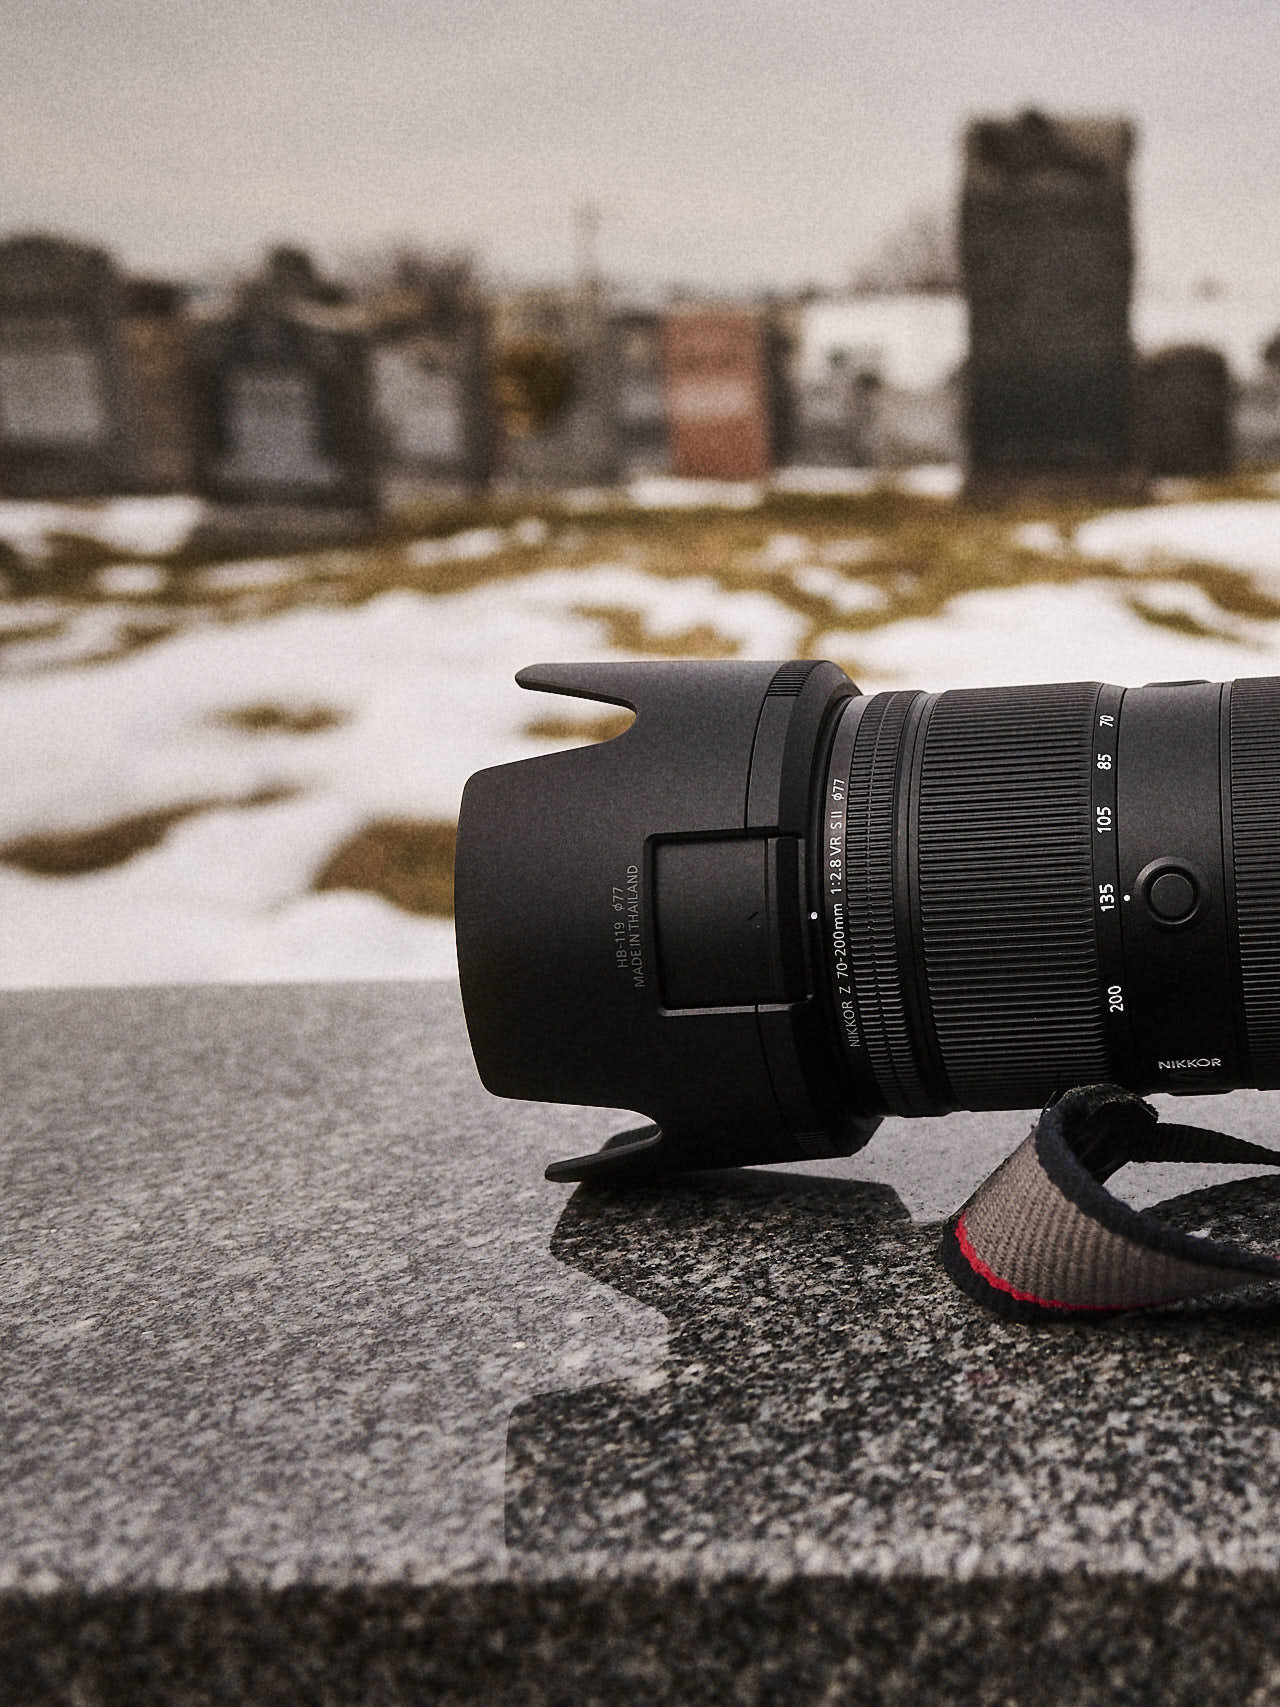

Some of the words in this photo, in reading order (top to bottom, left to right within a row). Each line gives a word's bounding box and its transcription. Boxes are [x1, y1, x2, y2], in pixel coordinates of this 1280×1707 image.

[1099, 714, 1115, 728] 70
[1096, 753, 1112, 770] 85
[830, 822, 842, 830] S
[1096, 806, 1112, 834] 105
[829, 836, 842, 857] VR
[829, 859, 842, 895] 1:2.8
[626, 865, 640, 931] THAILAND
[1098, 883, 1115, 912] 135
[614, 922, 629, 968] HB-119
[629, 934, 641, 946] IN
[832, 903, 849, 979] 70-200mm
[631, 950, 646, 988] MADE
[839, 985, 851, 994] Z
[1107, 985, 1124, 1013] 200
[841, 1000, 861, 1047] NIKKOR
[1157, 1058, 1222, 1070] NIKKOR
